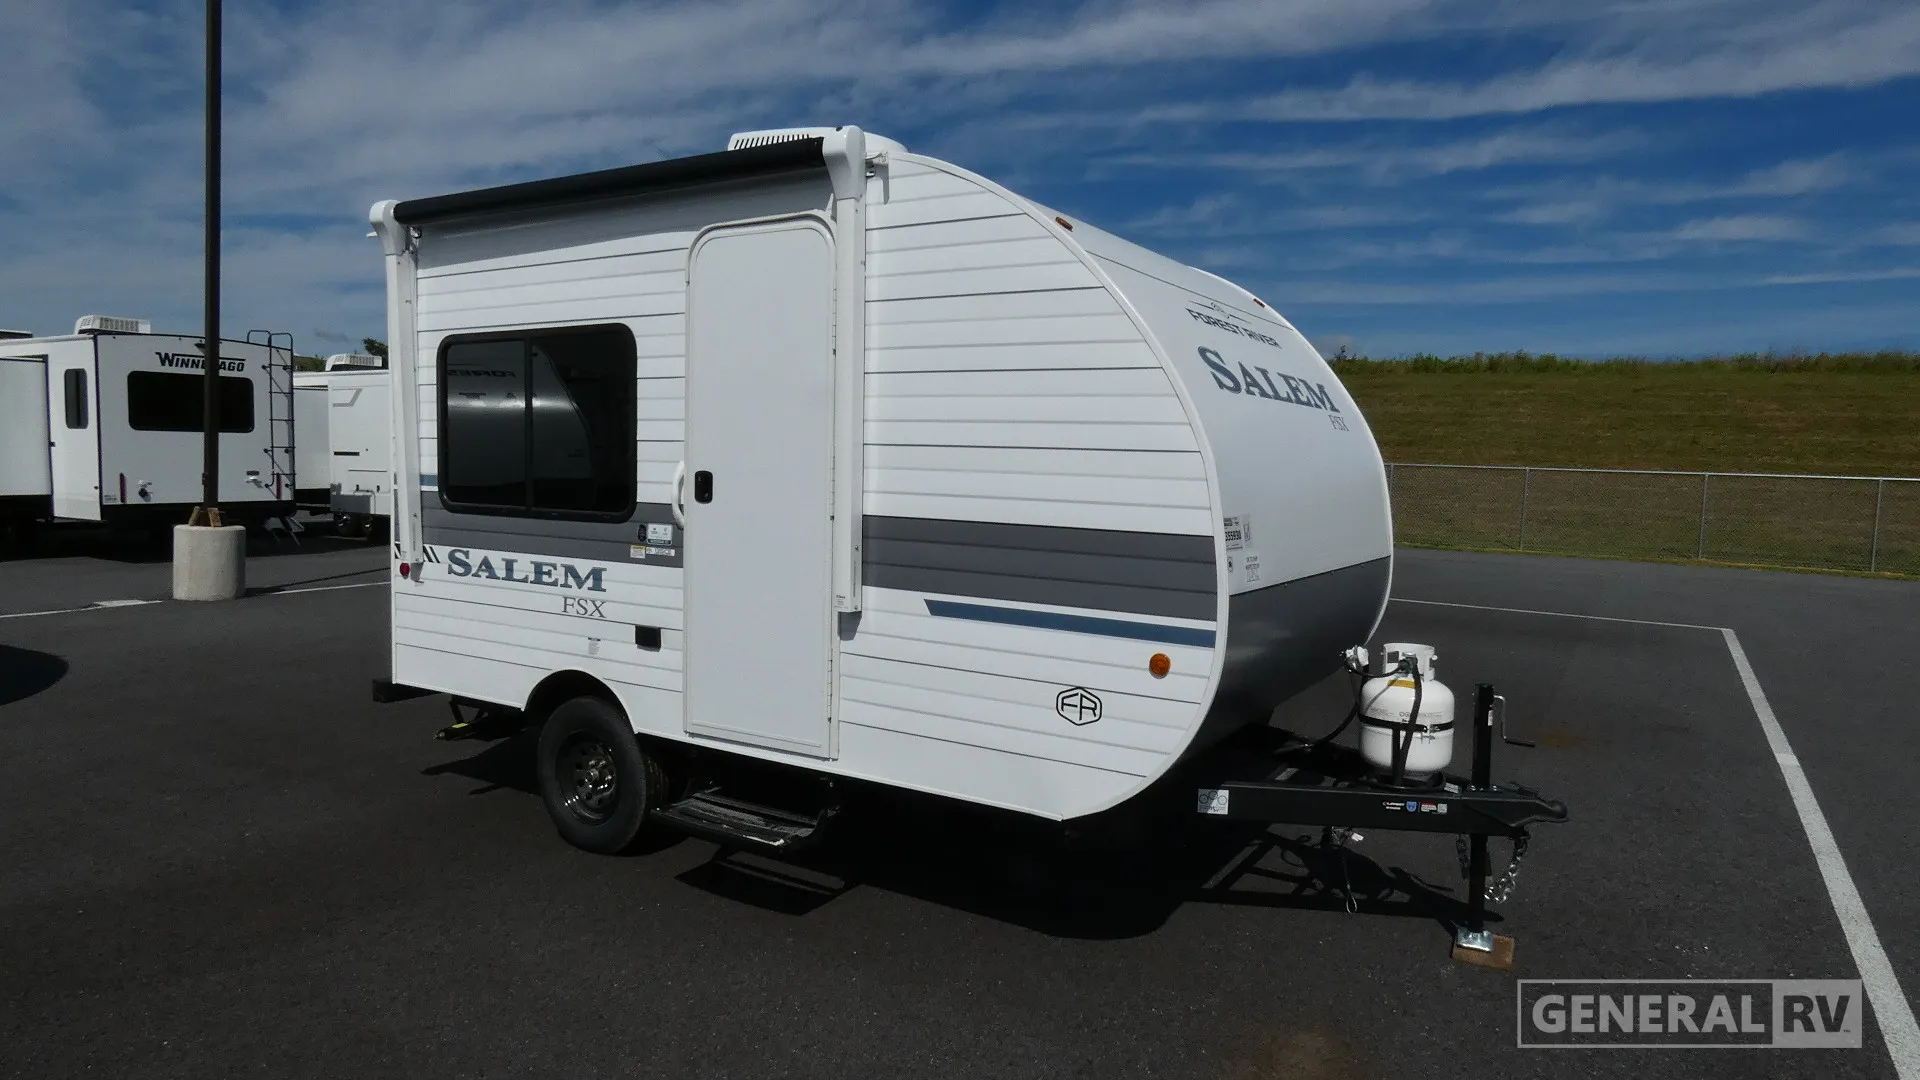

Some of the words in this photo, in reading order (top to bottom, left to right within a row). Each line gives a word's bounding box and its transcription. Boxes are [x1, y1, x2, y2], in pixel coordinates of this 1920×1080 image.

[1185, 308, 1244, 336] FOREST
[1242, 327, 1283, 349] RIVER
[155, 352, 246, 372] WINNAGO
[1198, 346, 1340, 413] SALEM
[1328, 414, 1350, 431] FSX
[448, 549, 607, 592] SALEM
[561, 596, 607, 618] FSX
[1061, 692, 1097, 721] FR
